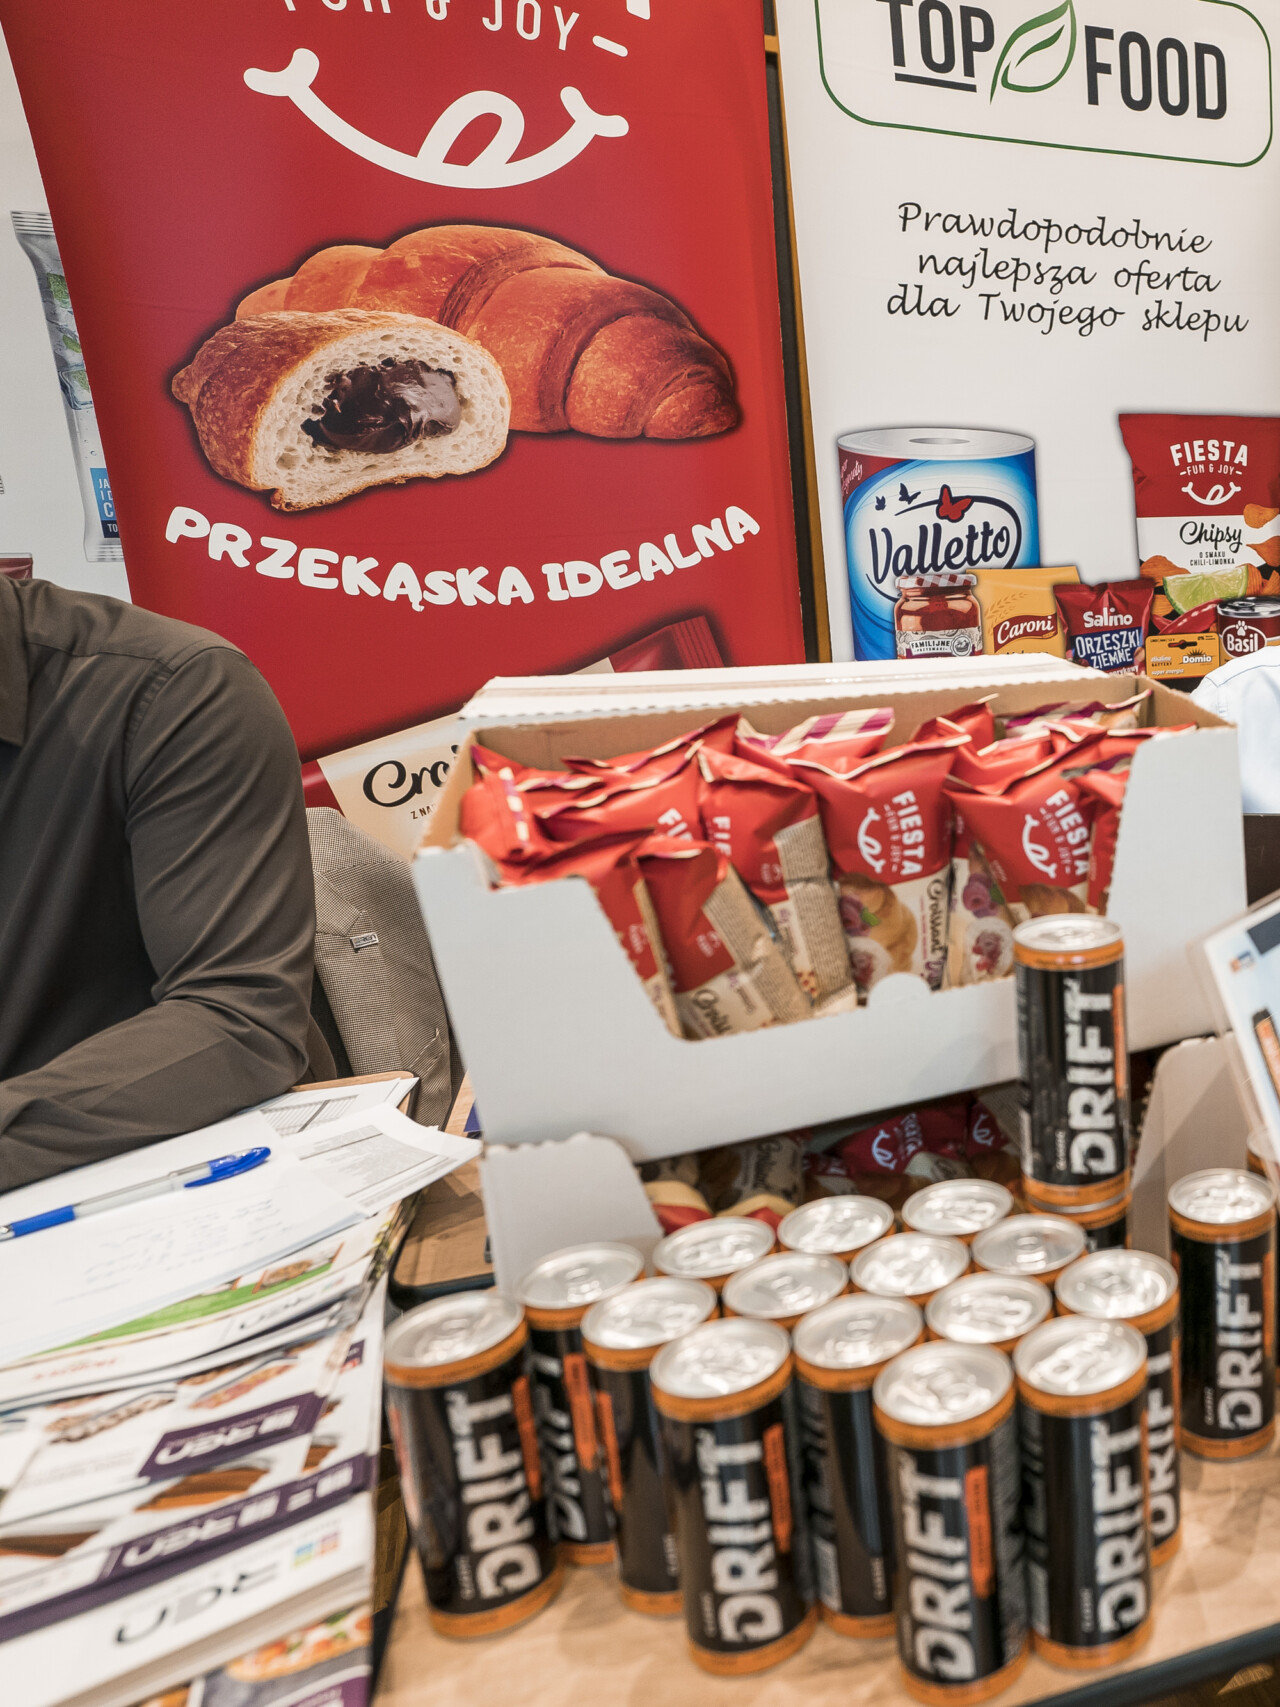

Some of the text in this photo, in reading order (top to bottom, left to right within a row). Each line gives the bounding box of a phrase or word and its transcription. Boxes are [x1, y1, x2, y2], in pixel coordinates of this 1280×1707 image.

[482, 0, 580, 50] JOY
[876, 0, 1227, 120] TOP FOOD
[898, 202, 1212, 254] Prawdopodobnie
[918, 248, 1221, 295] najlepsza oferta
[886, 284, 1249, 341] dla Twojego sklepu
[1170, 439, 1248, 467] FIESTA
[1186, 463, 1205, 476] FUN
[1217, 464, 1235, 476] JOY
[165, 505, 761, 613] PRZEKĄSKA IDEALNA
[869, 521, 1010, 585] Valletto
[1180, 521, 1243, 554] Chipsy
[997, 616, 1055, 644] Caroni
[1075, 629, 1140, 658] ORZESZKI
[1083, 607, 1133, 628] Salino
[1226, 633, 1259, 652] Basil
[911, 640, 951, 649] FAMILIJNE
[1091, 648, 1132, 669] ZIEMNE
[1182, 655, 1212, 664] Domio
[891, 790, 924, 876] FIESTA
[1046, 789, 1090, 876] FIESTA
[1063, 978, 1117, 1175] DRIFT
[1215, 1249, 1263, 1430] DRIFT
[445, 1390, 543, 1600] DRIFT
[695, 1427, 783, 1642] DRIFT
[1091, 1420, 1148, 1634] DRIFT
[900, 1450, 976, 1680] DRIFT
